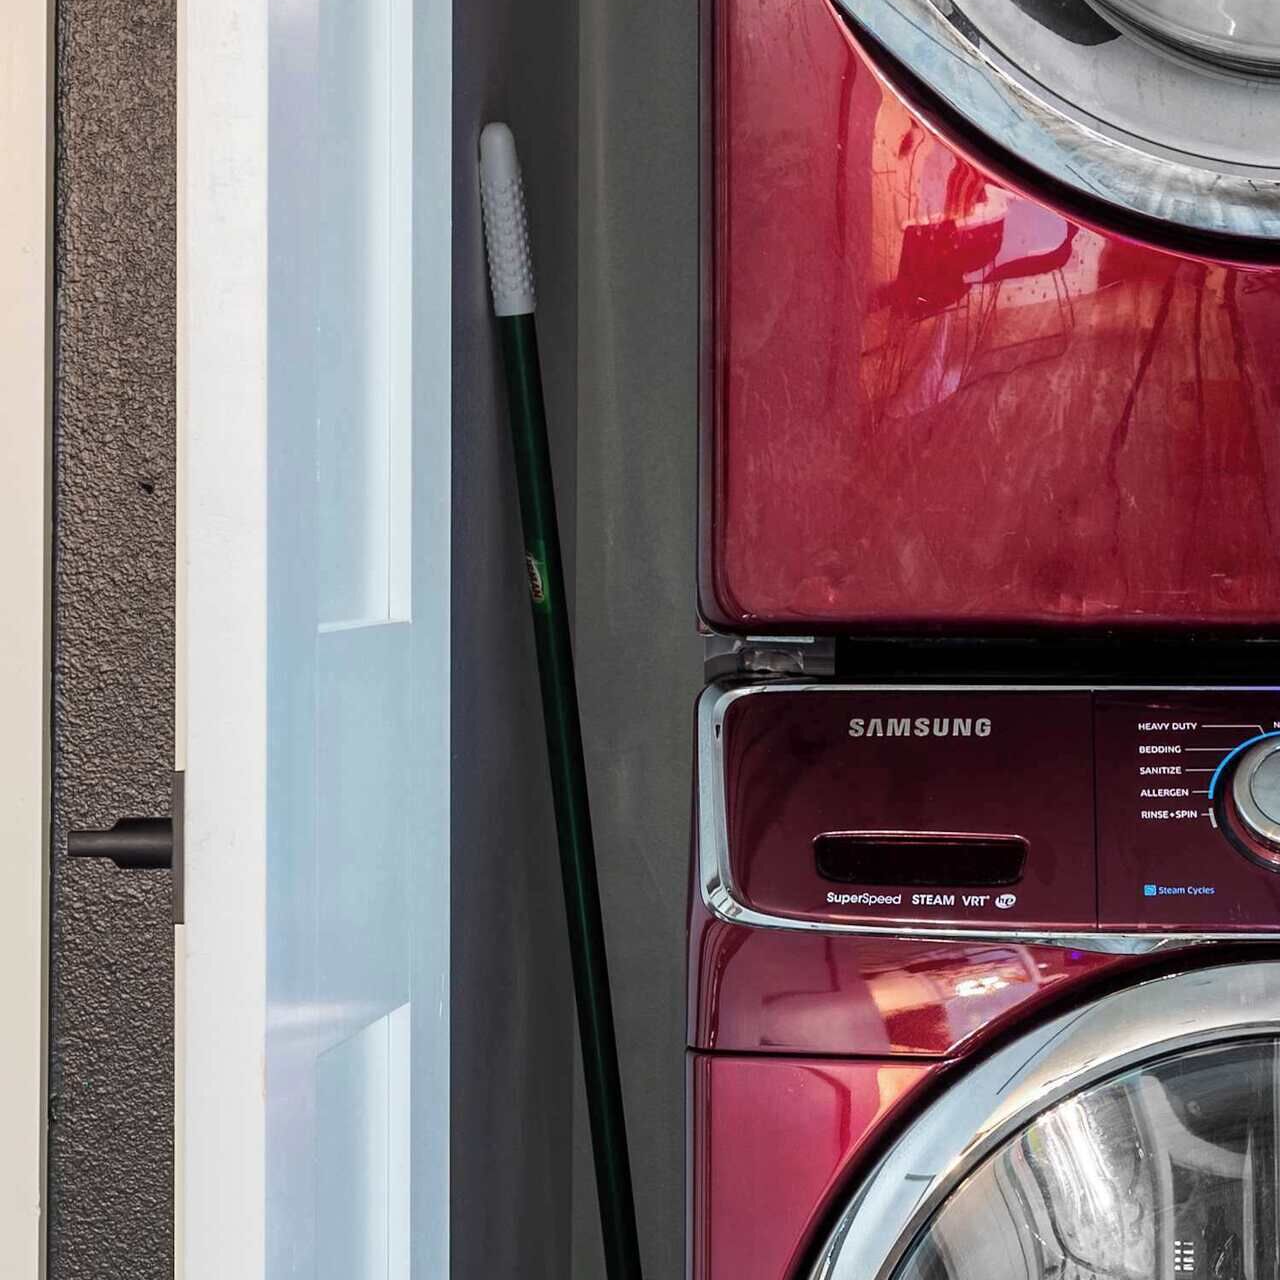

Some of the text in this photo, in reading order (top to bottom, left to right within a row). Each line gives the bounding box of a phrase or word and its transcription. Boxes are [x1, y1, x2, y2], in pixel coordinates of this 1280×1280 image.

[848, 718, 992, 737] SAMSUNG
[1172, 722, 1197, 730] DUTY
[1140, 766, 1182, 775] SANITIZE
[1140, 788, 1189, 797] ALLERGEN
[1141, 810, 1197, 818] RINSE+SPIN
[1158, 886, 1215, 895] Steam Cycles
[827, 892, 902, 905] SuperSpeed
[912, 894, 955, 905] STEAM
